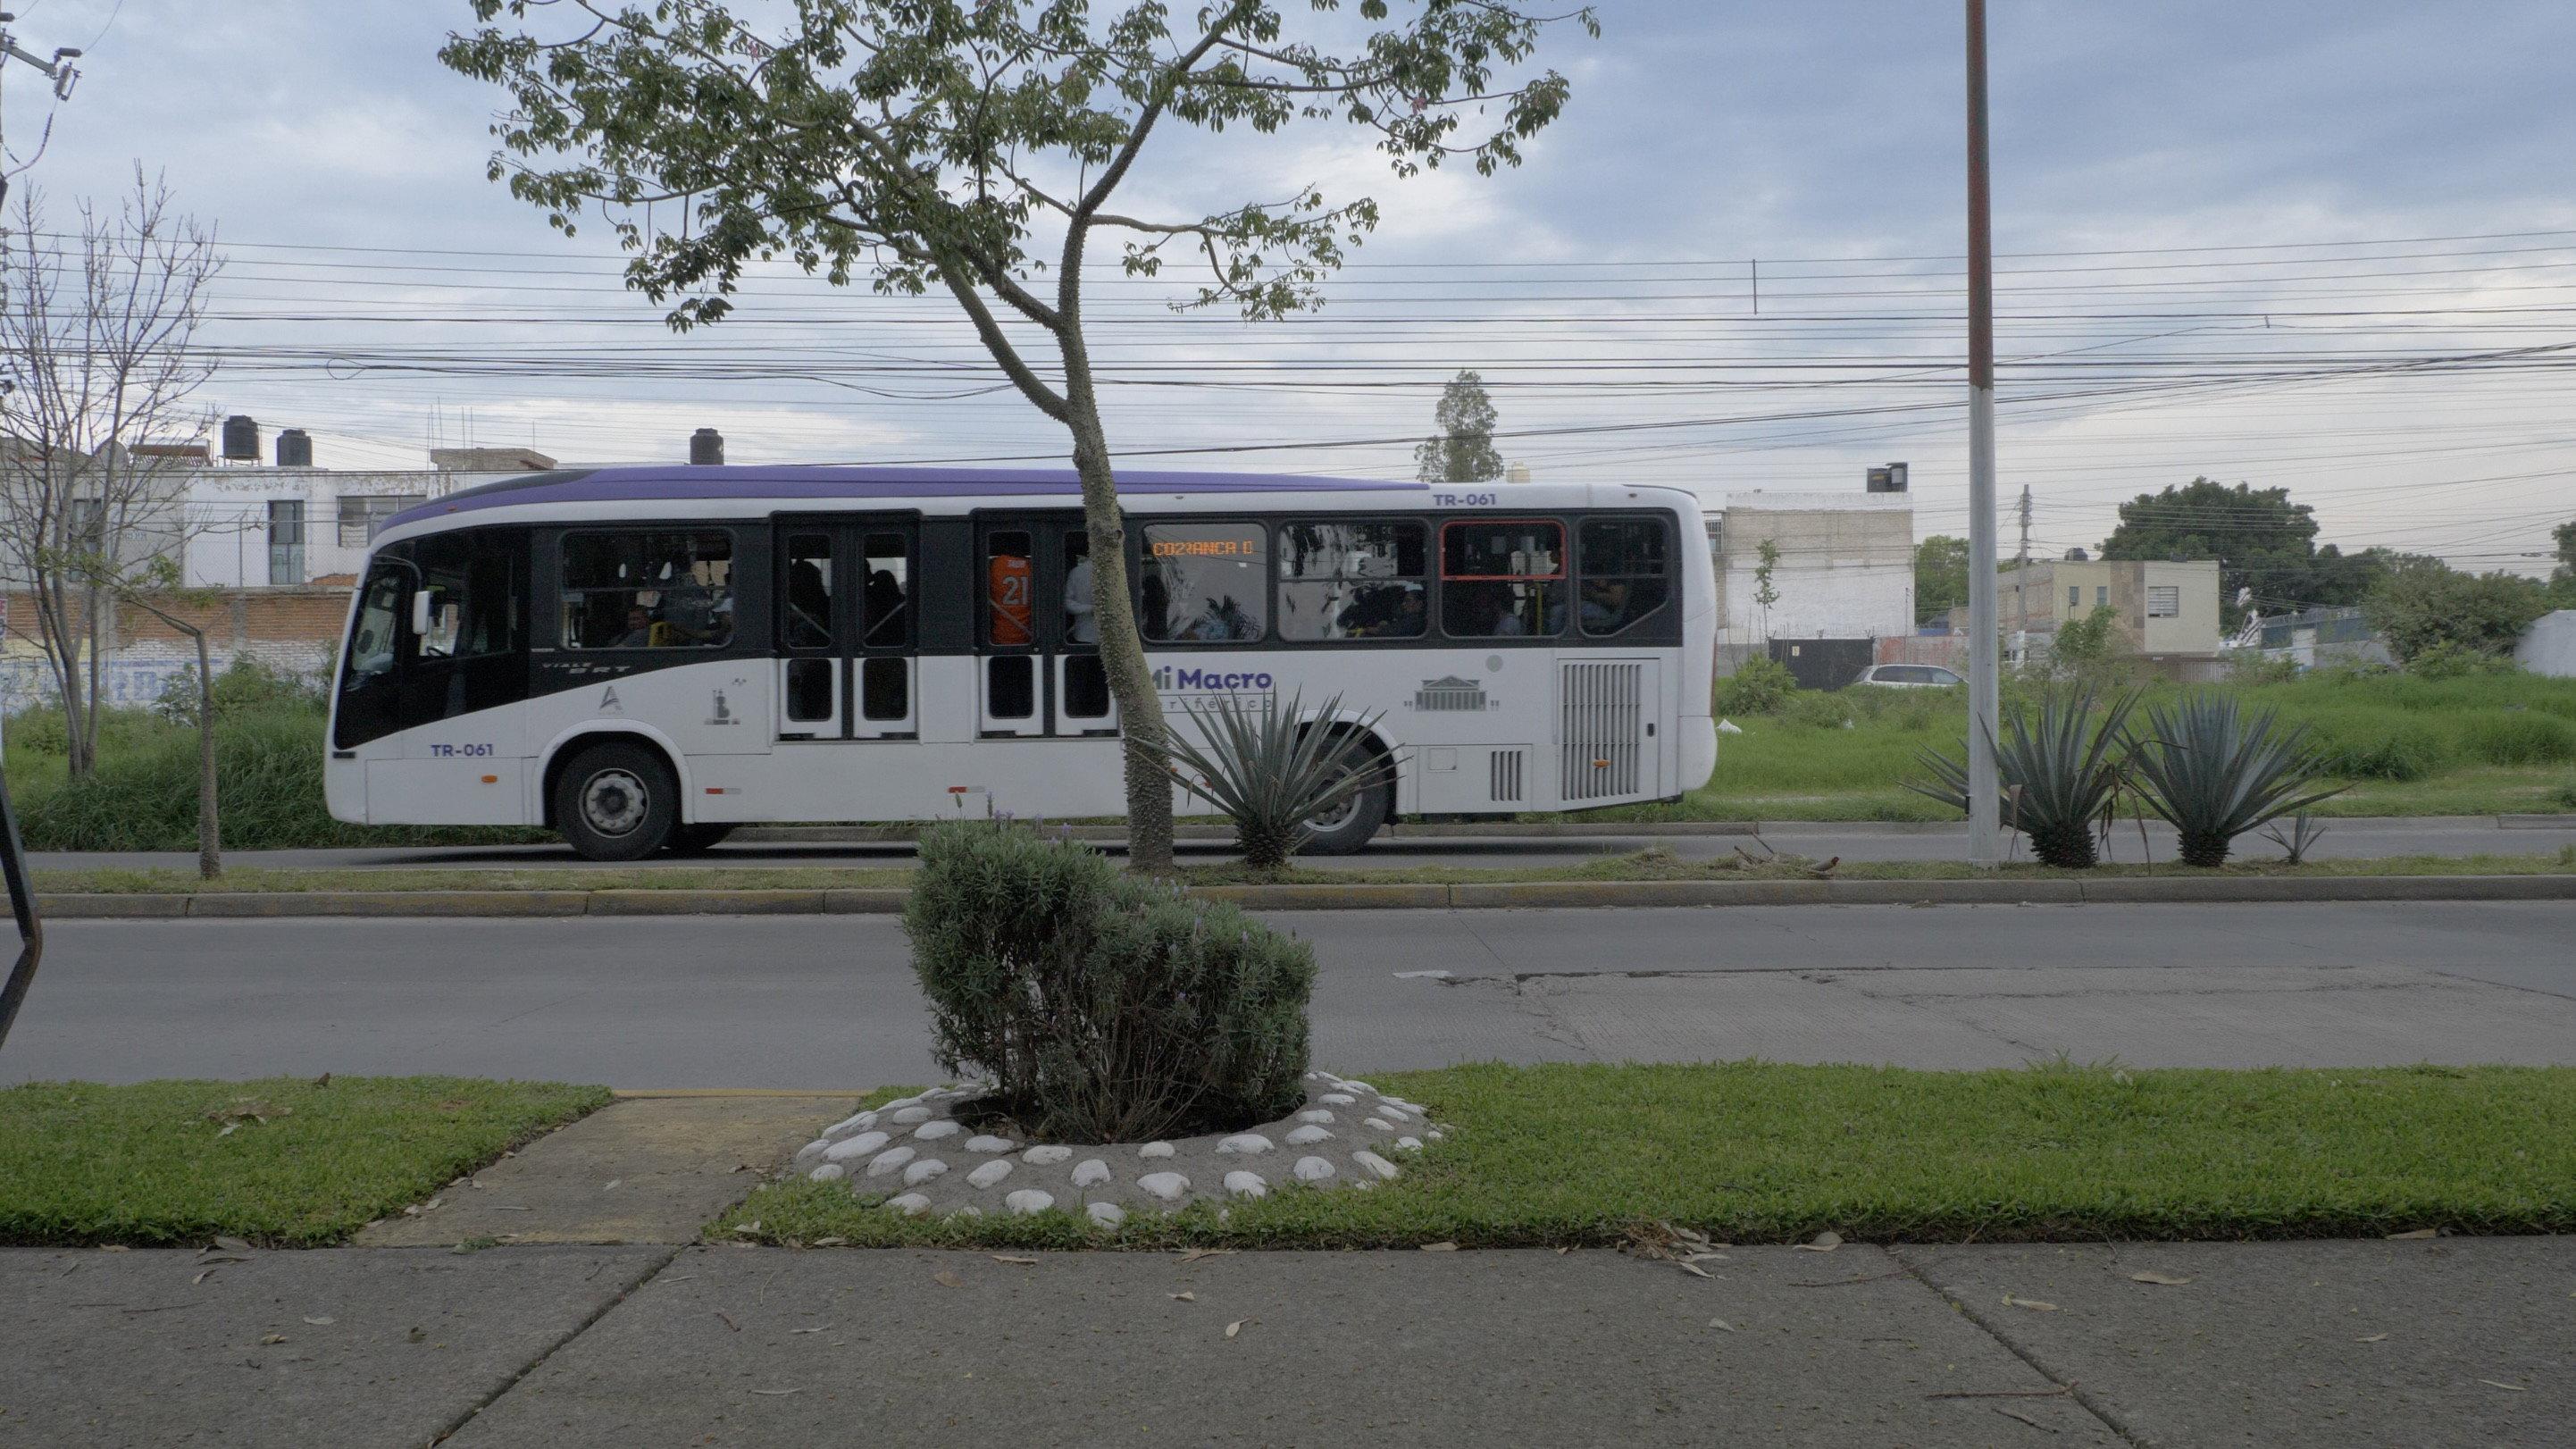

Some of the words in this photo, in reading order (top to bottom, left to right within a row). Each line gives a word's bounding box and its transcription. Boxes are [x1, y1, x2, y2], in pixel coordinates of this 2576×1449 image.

[1432, 493, 1496, 507] TR-061
[1002, 576, 1029, 606] 21
[1177, 668, 1273, 690] Macro
[431, 742, 494, 758] TR-061
